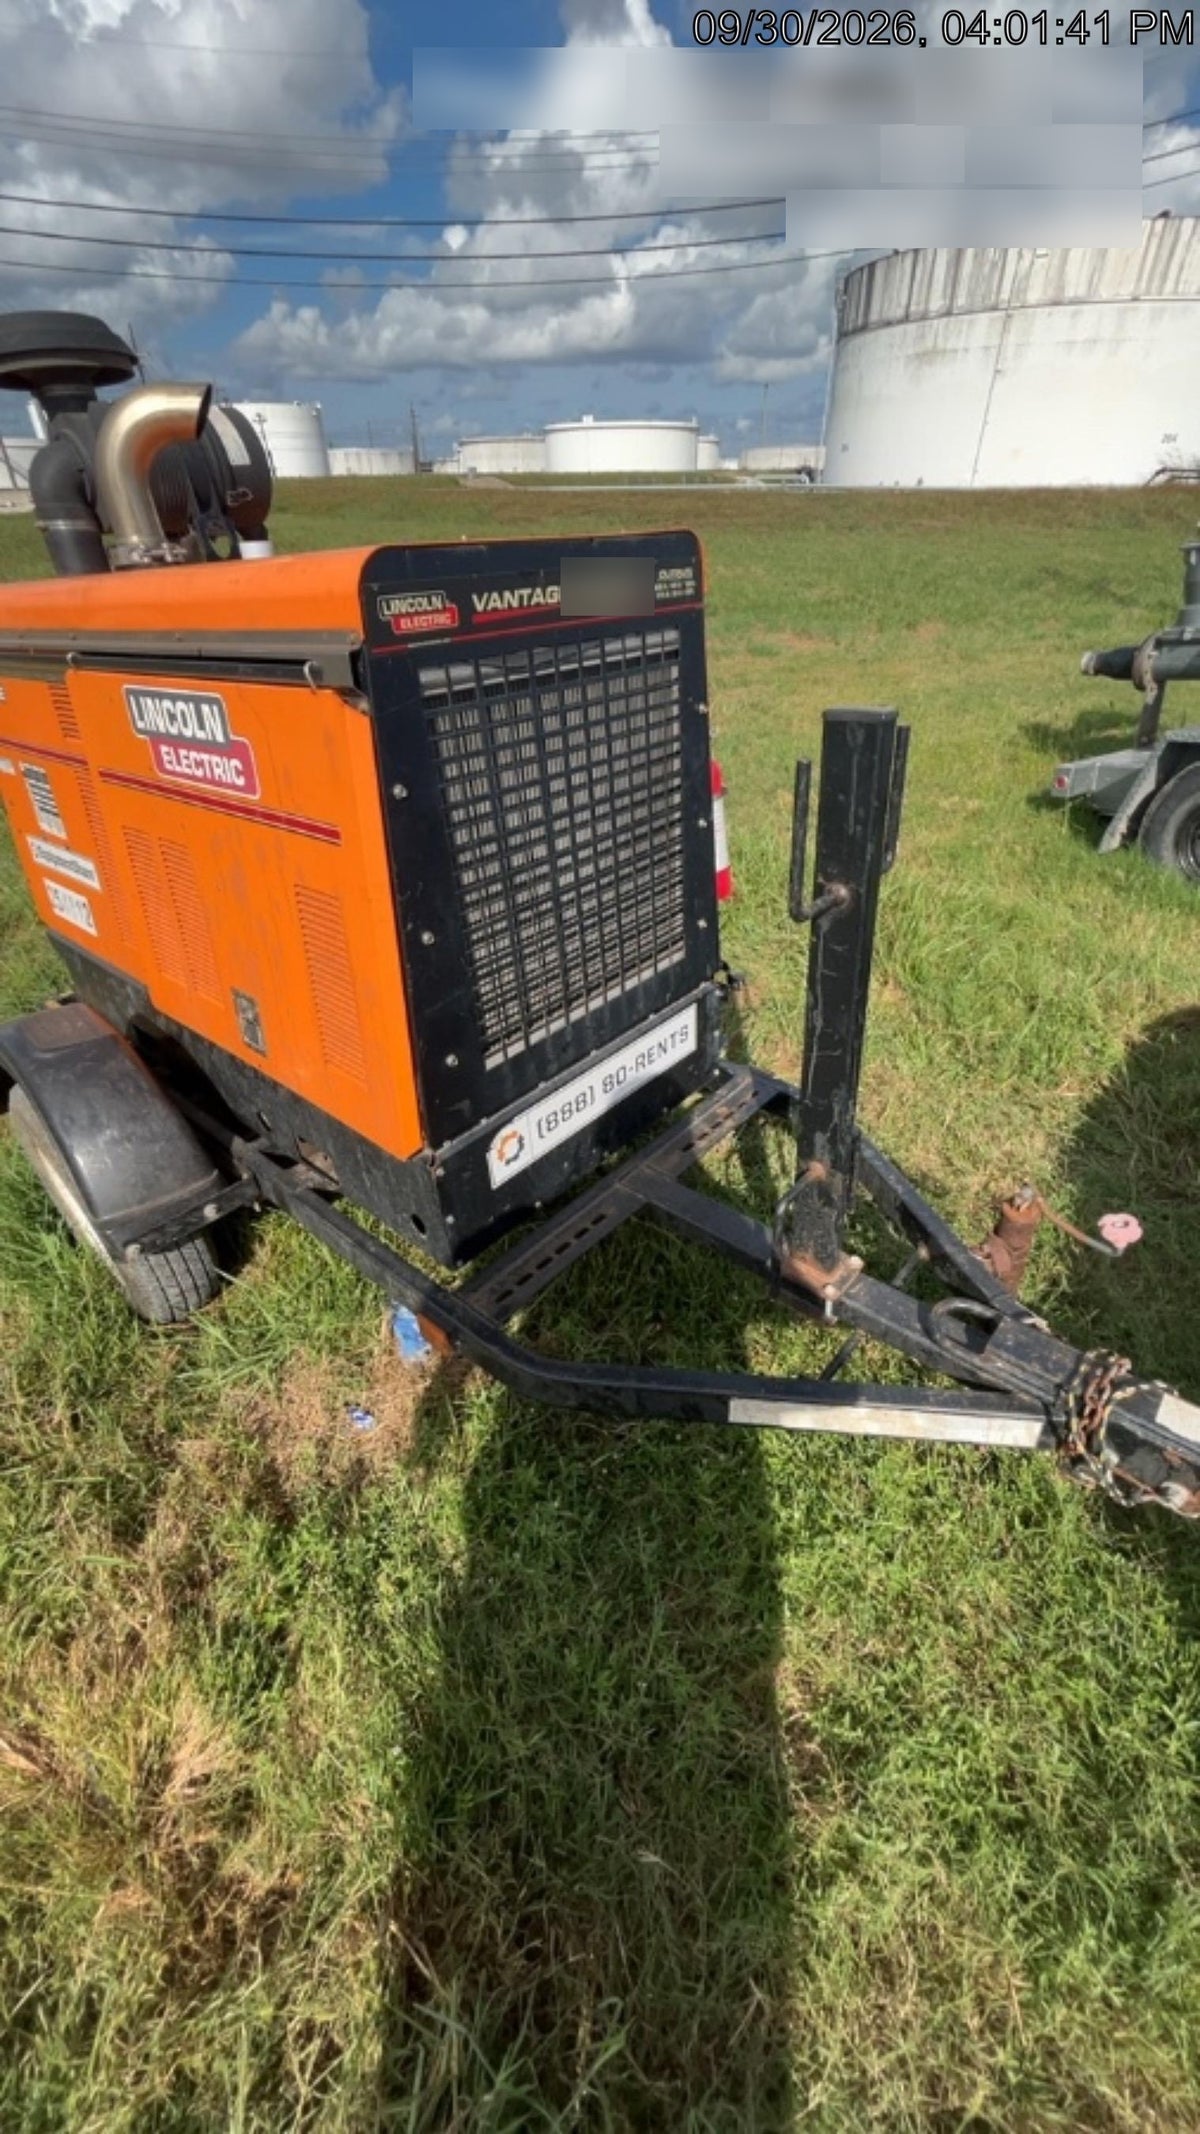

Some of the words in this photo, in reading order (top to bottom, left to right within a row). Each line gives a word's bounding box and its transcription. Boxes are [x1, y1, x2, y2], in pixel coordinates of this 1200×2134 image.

[381, 594, 443, 615] LINCOLN
[472, 585, 561, 613] VANTAG
[400, 612, 452, 630] ELECTRIC
[129, 694, 226, 743] LINCOLN
[159, 744, 245, 786] ELECTRIC
[601, 1023, 689, 1094] 80-RENTS
